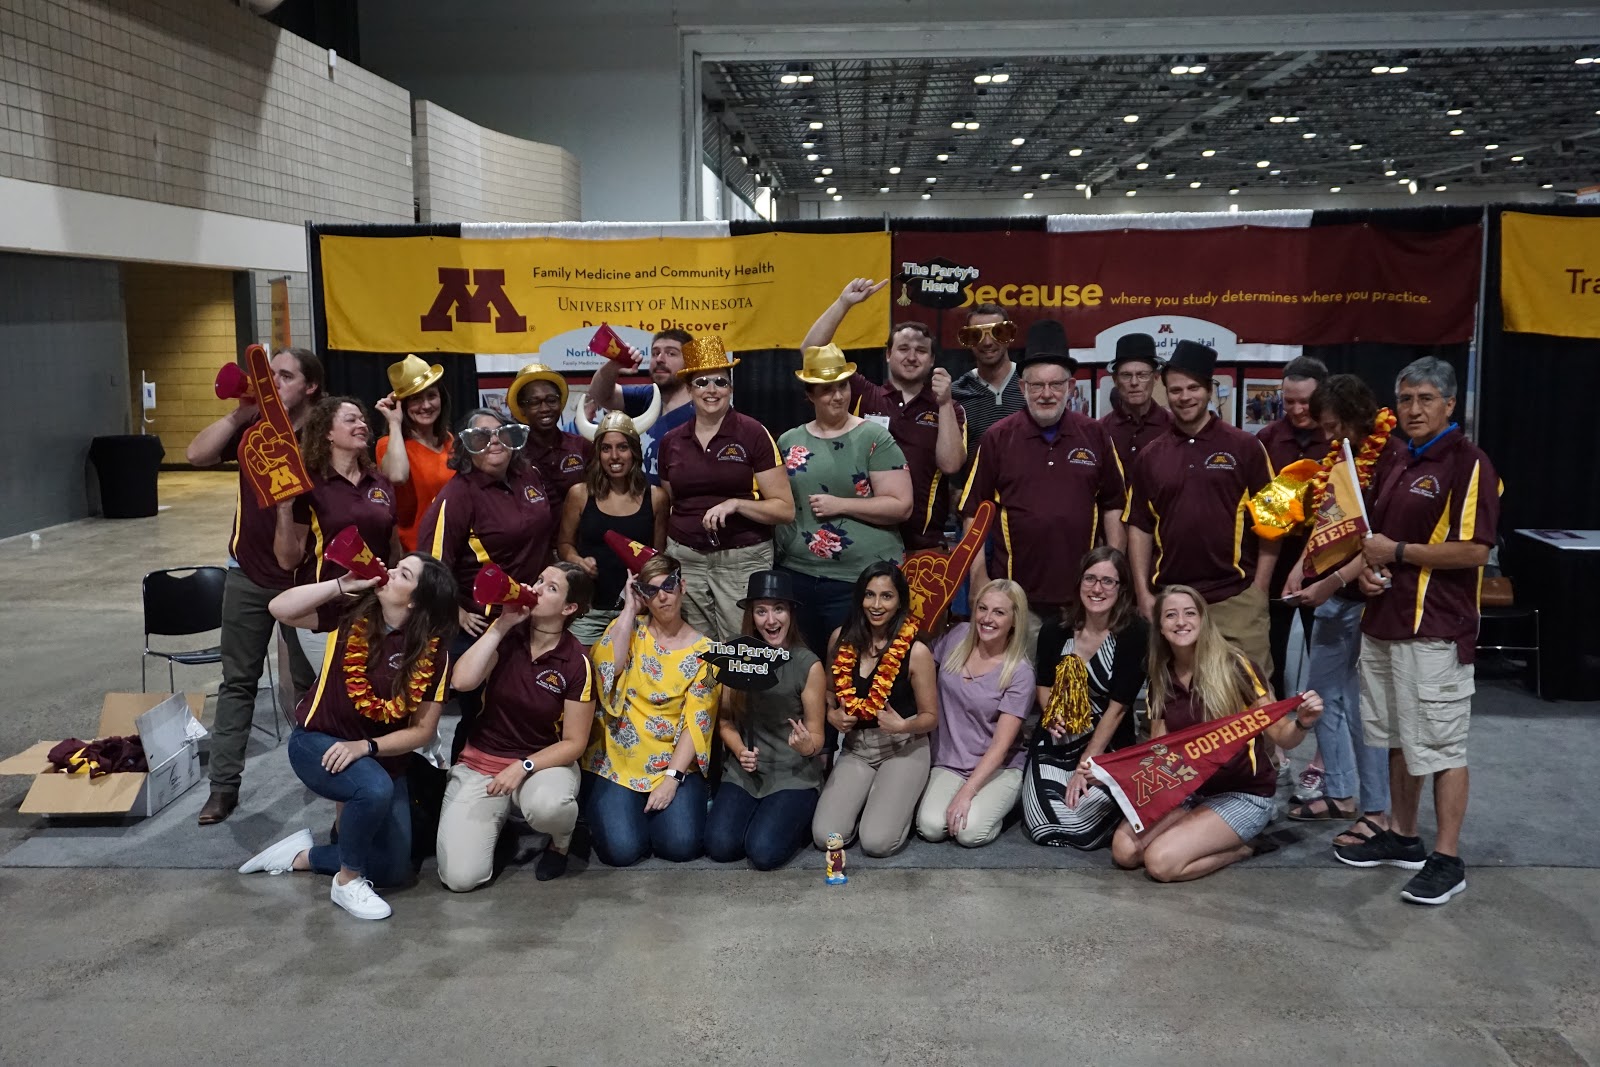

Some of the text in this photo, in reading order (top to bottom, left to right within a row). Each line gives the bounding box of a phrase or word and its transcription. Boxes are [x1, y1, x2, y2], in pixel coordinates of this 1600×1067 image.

[533, 261, 775, 281] Family Medicine and Community Health
[902, 262, 979, 280] The Party's
[921, 280, 959, 293] Here!
[420, 267, 528, 333] M
[558, 296, 754, 313] UNIVERSITY OF MINNESOTA
[1110, 291, 1152, 305] where
[1155, 295, 1179, 307] you
[1183, 291, 1218, 306] study
[1221, 290, 1298, 303] determines
[1302, 291, 1342, 303] where
[1346, 290, 1368, 304] you
[1372, 291, 1432, 304] practice.
[639, 320, 655, 331] to
[661, 319, 729, 331] Discover
[707, 641, 790, 662] The Party's
[728, 659, 769, 675] Here!
[1184, 708, 1271, 760] GOPHERS
